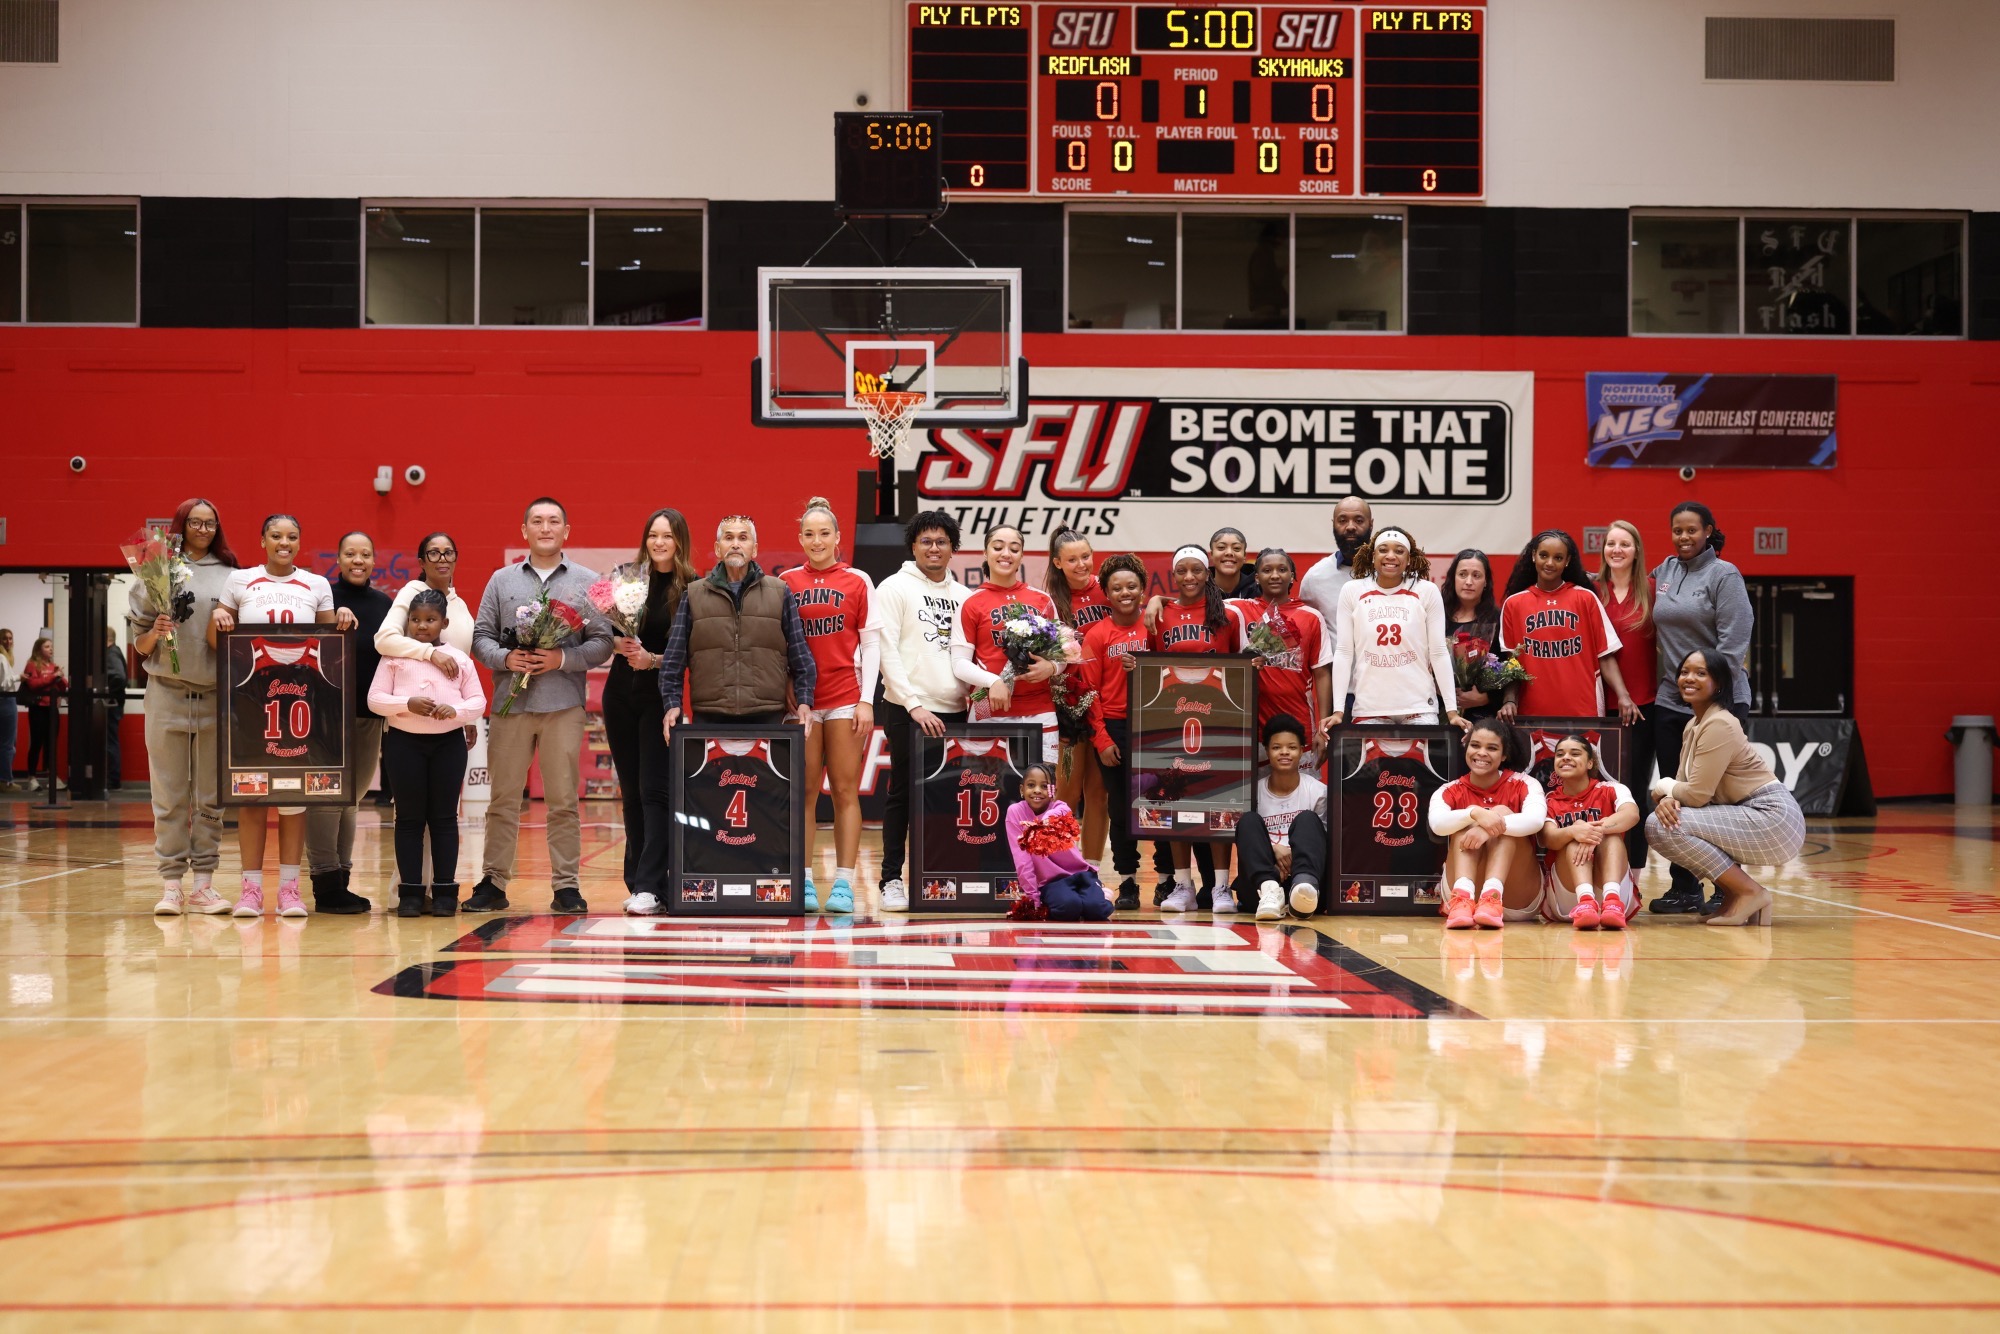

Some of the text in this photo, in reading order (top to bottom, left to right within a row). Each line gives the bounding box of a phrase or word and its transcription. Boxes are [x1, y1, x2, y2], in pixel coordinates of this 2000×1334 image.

[920, 7, 1020, 25] PLY FL PTS
[1372, 12, 1472, 31] PLY FL PTS
[1051, 11, 1117, 47] SFU
[1167, 10, 1253, 48] 5:00
[1275, 13, 1339, 48] SFU
[1049, 56, 1130, 75] REDFLASH
[1174, 68, 1218, 81] PERIOD
[1258, 58, 1344, 77] SKYHAWKS
[1097, 82, 1118, 119] 0
[1199, 89, 1206, 115] 1
[1312, 84, 1333, 121] 0
[866, 122, 931, 150] 5:00
[1052, 126, 1092, 138] FOULS
[1106, 126, 1140, 138] T.O.L.
[1156, 126, 1238, 139] PLAYER FOUL
[1252, 127, 1286, 139] T.O.L.
[1299, 127, 1339, 140] FOULS
[1068, 141, 1086, 170] 0
[1114, 141, 1132, 171] 0
[1260, 142, 1277, 173] 0
[1315, 143, 1333, 173] 0
[970, 164, 984, 187] 0
[1052, 178, 1092, 190] SCORE
[1174, 179, 1217, 192] MATCH
[1423, 169, 1436, 191] 0
[1299, 180, 1339, 193] SCORE
[1758, 303, 1836, 331] Flash
[1602, 386, 1674, 394] NORTHEAST
[1170, 408, 1491, 444] BECOME THAT
[1596, 403, 1680, 440] NEC
[1688, 410, 1836, 428] NORTHEAST CONFERENCE
[918, 400, 1151, 497] SFU
[1170, 446, 1488, 496] SOMEONE
[932, 507, 1120, 536] THLETICS
[1758, 533, 1783, 550] EXIT
[256, 593, 303, 608] SAINT
[1368, 606, 1410, 622] SAINT
[1525, 610, 1579, 633] SAINT
[800, 614, 845, 637] RANCIS
[1376, 623, 1402, 646] 23
[1162, 624, 1214, 650] SAINT
[1524, 635, 1583, 658] FRANCIS
[1364, 650, 1417, 668] FRANCIS
[267, 678, 308, 697] Saint
[1174, 697, 1212, 715] Saint
[264, 700, 311, 739] 10
[1182, 717, 1203, 755] 0
[266, 741, 308, 758] Francis
[1172, 757, 1212, 773] Francis
[719, 769, 758, 788] Saint
[959, 768, 997, 787] Saint
[1377, 770, 1416, 788] Saint
[725, 790, 748, 828] 4
[956, 789, 1000, 827] 15
[1372, 791, 1419, 829] 23
[716, 830, 757, 846] Francis
[956, 828, 997, 845] Francis
[1374, 831, 1415, 847] Francis
